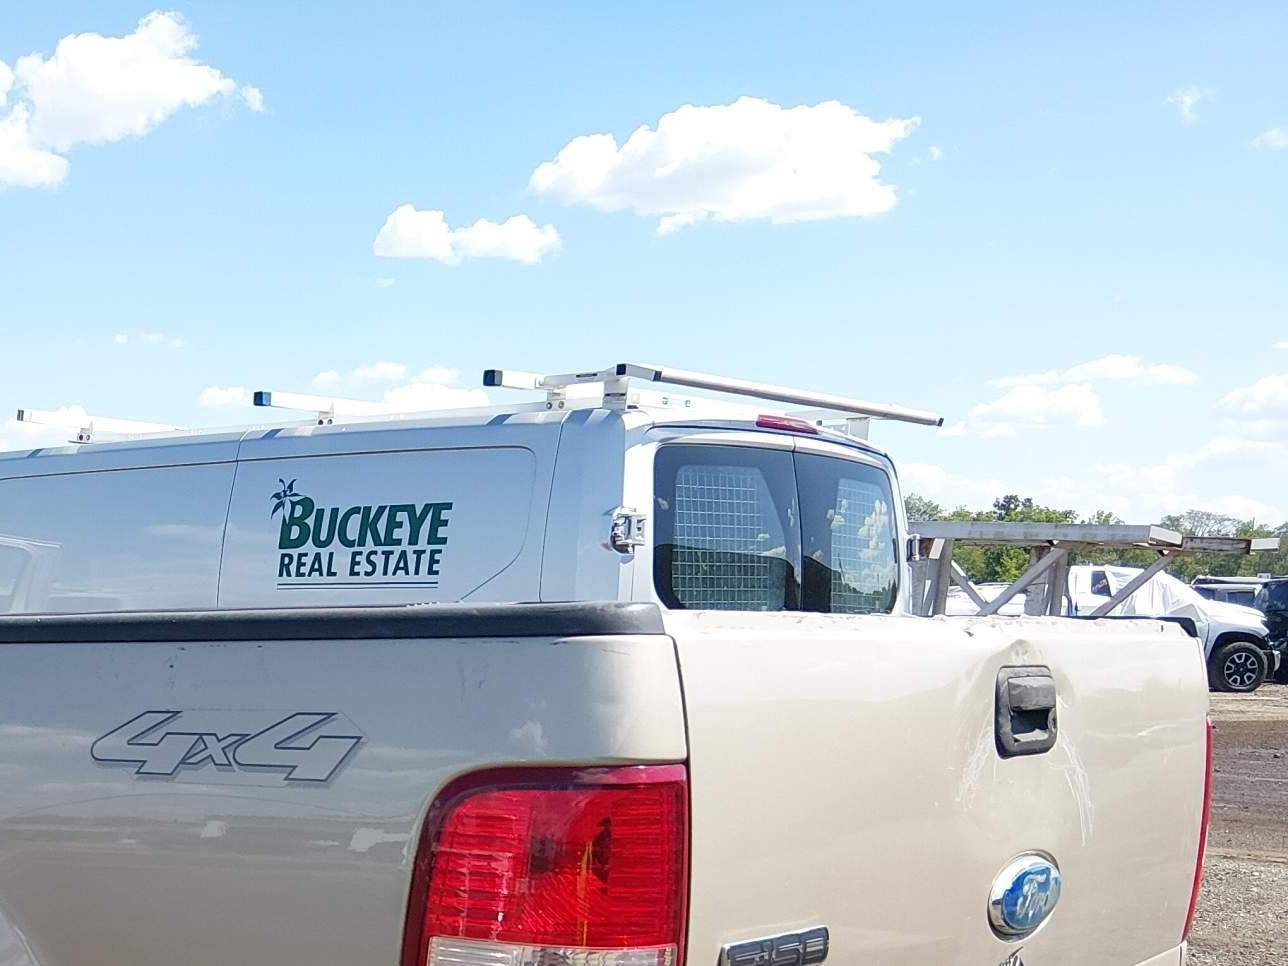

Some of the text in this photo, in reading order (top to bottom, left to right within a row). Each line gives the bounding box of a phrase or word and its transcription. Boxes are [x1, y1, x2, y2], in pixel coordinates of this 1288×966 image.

[278, 496, 453, 549] BUCKEYE
[277, 549, 442, 577] REAL ESTATE
